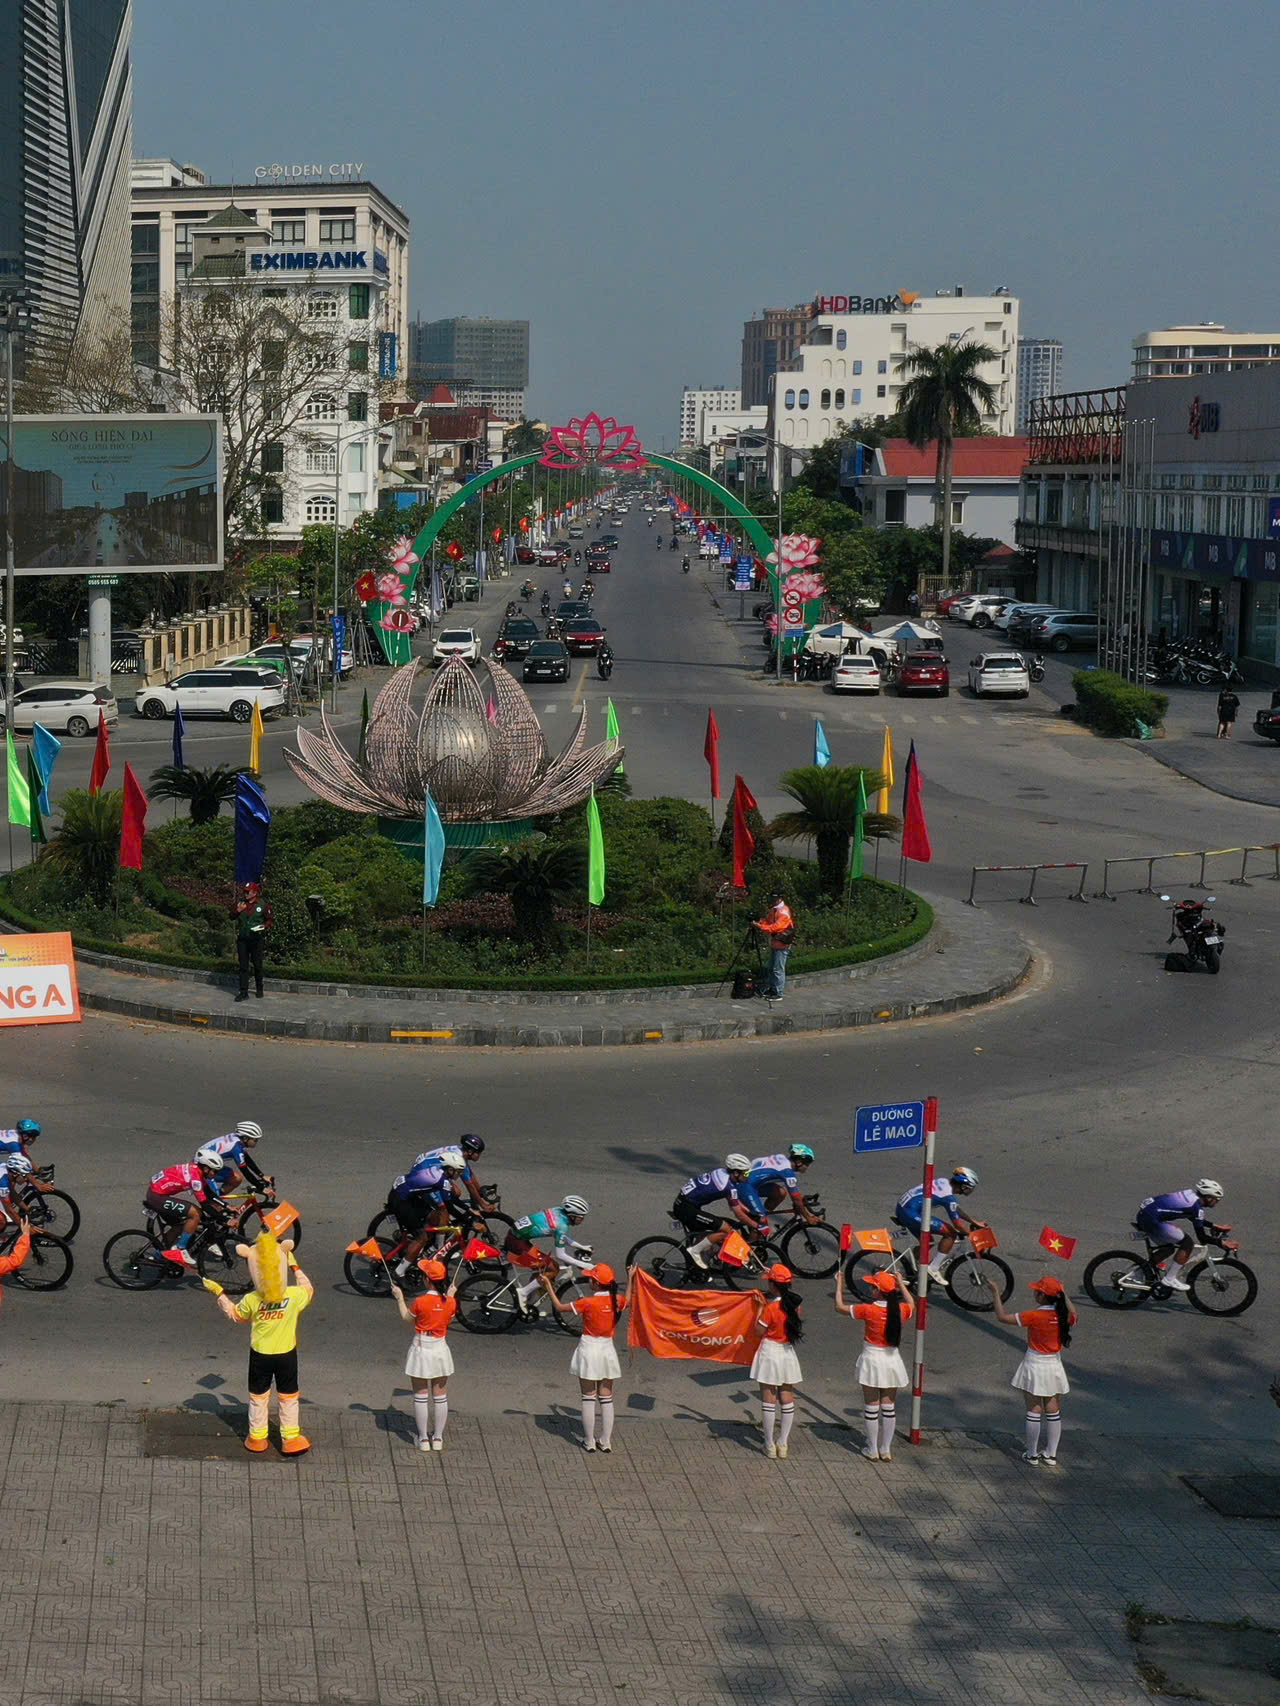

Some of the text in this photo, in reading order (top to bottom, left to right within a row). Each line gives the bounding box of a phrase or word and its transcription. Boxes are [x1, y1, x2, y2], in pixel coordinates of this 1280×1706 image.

[328, 163, 363, 176] CITY
[250, 250, 368, 271] EXIMBANK
[821, 295, 899, 312] HDBank
[42, 983, 66, 1008] A
[872, 1107, 913, 1122] ĐƯỜNG
[864, 1124, 917, 1142] LÊ MAO
[690, 1335, 733, 1346] DONG
[733, 1334, 745, 1345] A
